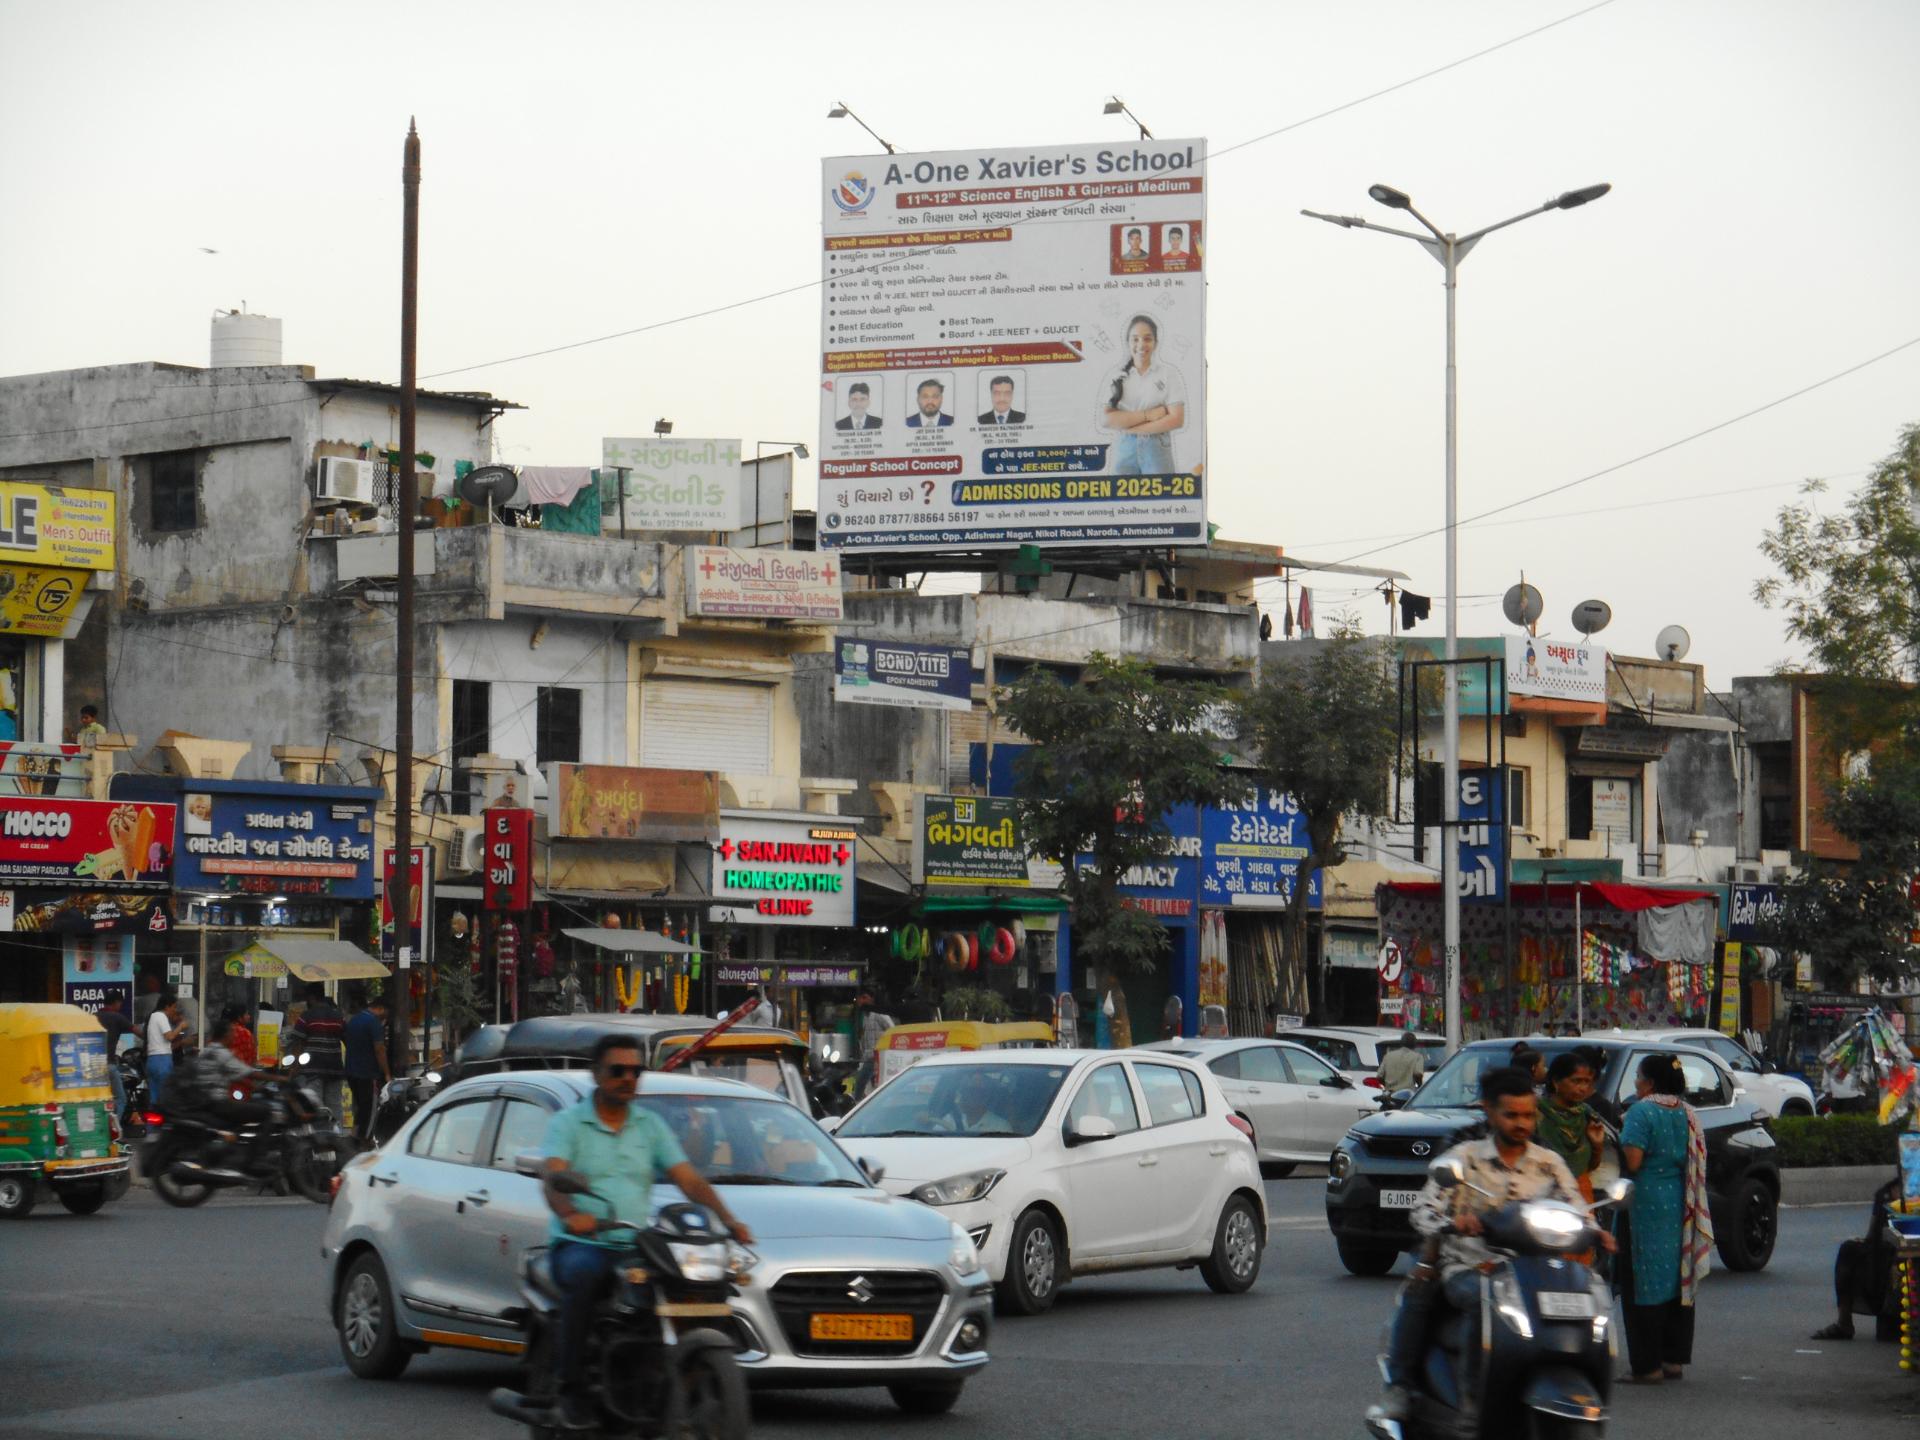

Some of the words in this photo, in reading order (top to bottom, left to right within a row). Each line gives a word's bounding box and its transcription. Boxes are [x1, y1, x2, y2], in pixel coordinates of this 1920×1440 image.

[884, 161, 969, 186] A-One
[978, 153, 1086, 180] Xavier's
[1096, 147, 1193, 174] School
[960, 190, 1011, 202] Science
[1015, 186, 1064, 201] English
[1068, 185, 1077, 197] &
[1081, 182, 1134, 198] Gujarati
[1138, 180, 1191, 193] Medium
[958, 209, 978, 221] અને
[838, 322, 857, 332] Best
[860, 320, 904, 330] Education
[949, 317, 969, 327] Best
[971, 316, 994, 325] Team
[838, 335, 858, 345] Best
[860, 332, 915, 343] Environment
[949, 329, 975, 339] Board
[1042, 325, 1080, 335] GUJCET
[827, 361, 856, 370] Gujarati
[857, 360, 886, 369] Medium
[952, 354, 987, 365] Managed
[987, 353, 1000, 364] By:
[1001, 353, 1020, 362] Team
[1022, 352, 1051, 362] Science
[828, 352, 854, 363] English
[630, 440, 716, 470] સંજીવની
[823, 459, 867, 474] Regular
[870, 457, 909, 472] School
[911, 457, 960, 473] Concept
[1021, 461, 1065, 472] JEE-NEET
[855, 488, 893, 503] વિચારો
[920, 479, 936, 505] ?
[961, 482, 1061, 501] ADMISSIONS
[1066, 479, 1111, 498] OPEN
[1116, 476, 1195, 497] 2025-26
[844, 514, 876, 526] 96240
[879, 512, 945, 525] 87877/88664
[948, 511, 979, 523] 56197
[43, 524, 74, 541] Men's
[79, 527, 112, 544] Outfit
[846, 534, 872, 544] A-One
[874, 532, 907, 544] Xavier's
[909, 531, 940, 543] School,
[942, 531, 963, 544] Opp.
[965, 529, 1004, 541] Adishwar
[1006, 530, 1034, 541] Nagar,
[1036, 528, 1058, 539] Nikol
[1060, 528, 1085, 538] Road,
[1087, 527, 1121, 538] Naroda,
[1122, 526, 1174, 537] Ahmedabad
[718, 556, 766, 583] સંજીવની
[878, 652, 915, 671] BOND
[919, 654, 948, 674] TITE
[886, 676, 906, 684] EPOXY
[906, 677, 939, 688] ADHESIVES
[4, 810, 72, 838] HOCCO
[245, 812, 285, 829] પ્રધાન
[926, 811, 947, 825] GRAND
[928, 817, 1014, 848] ભગવતી
[1230, 814, 1295, 845] ડેકોરેટર્સ
[187, 832, 247, 855] ભારતીય
[251, 839, 280, 856] જન
[738, 840, 833, 865] SANJIVANI
[12, 865, 23, 874] SAI
[23, 866, 41, 874] DAIRY
[41, 866, 69, 875] PARLOUR
[1247, 862, 1277, 877] ગાદલા,
[724, 869, 843, 893] HOMEOPATHIC
[757, 897, 814, 916] CLINIC
[73, 989, 105, 1001] BABA
